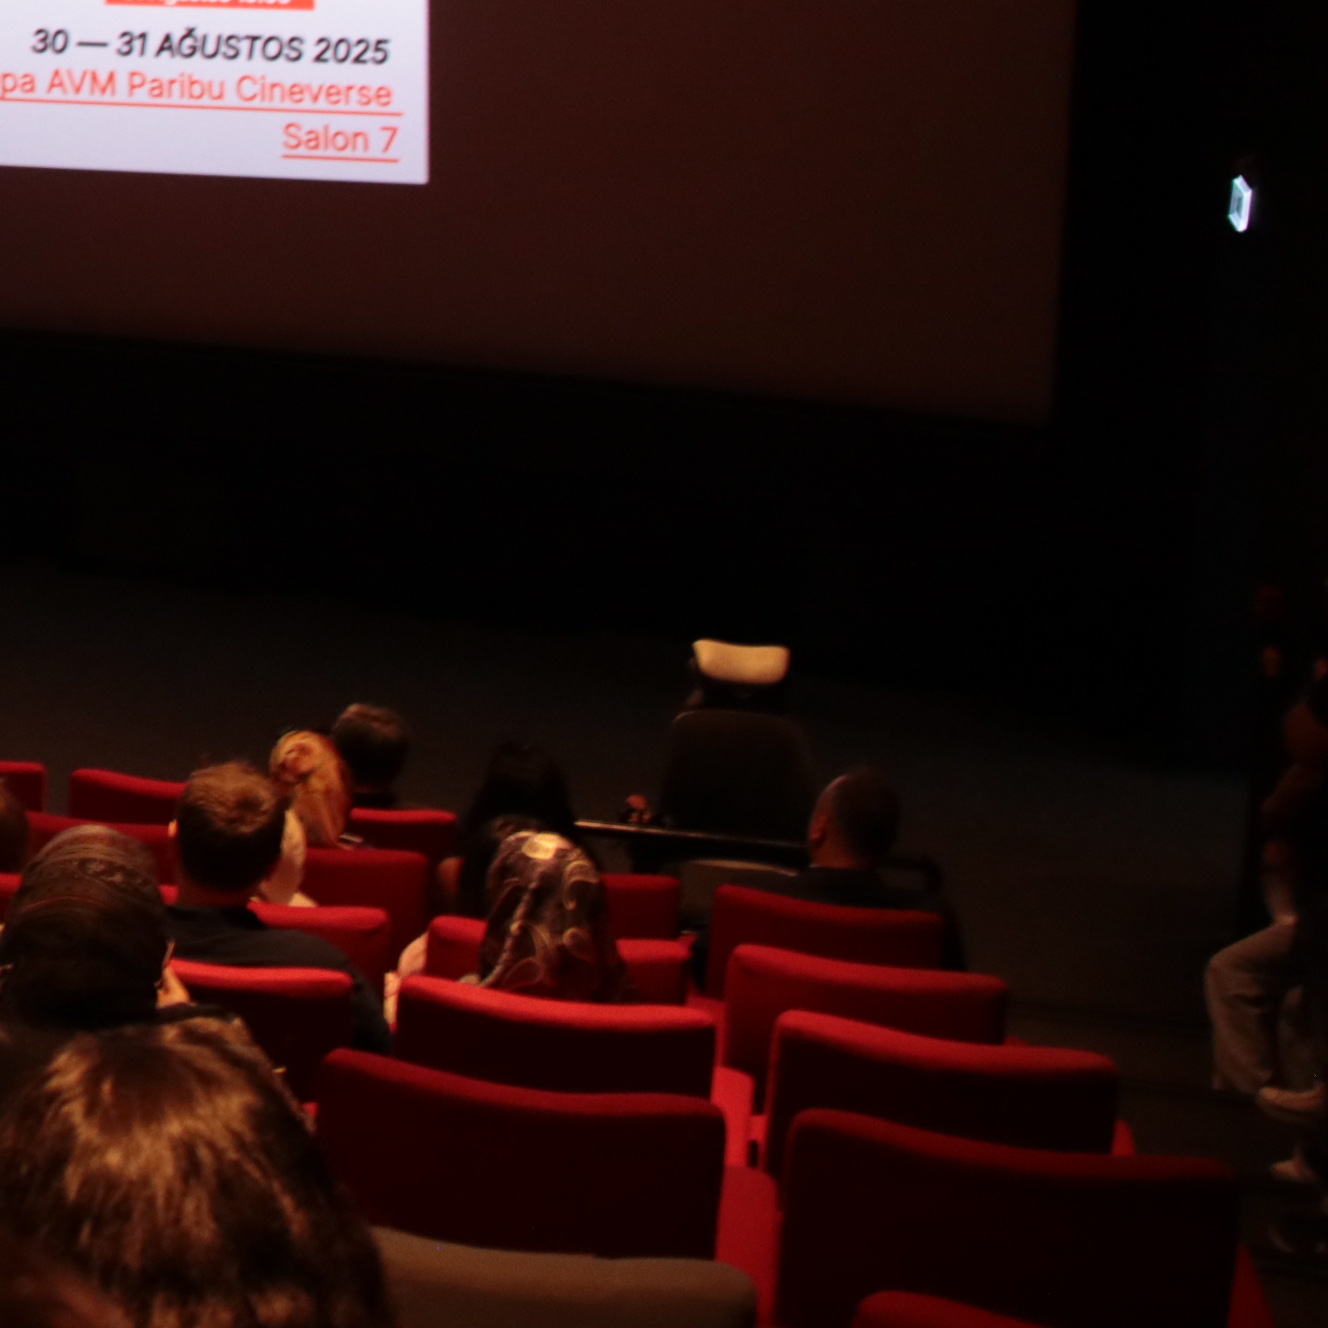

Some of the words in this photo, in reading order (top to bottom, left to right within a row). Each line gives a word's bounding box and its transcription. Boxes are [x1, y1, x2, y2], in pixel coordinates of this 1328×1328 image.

[30, 29, 68, 54] 30
[115, 31, 147, 56] 31
[155, 27, 304, 62] AĞUSTOS
[312, 37, 390, 65] 2025
[46, 69, 117, 97] AVM
[127, 70, 225, 102] Paribu
[236, 74, 394, 107] Cineverse
[282, 122, 370, 153] Salon
[379, 126, 400, 153] 7
